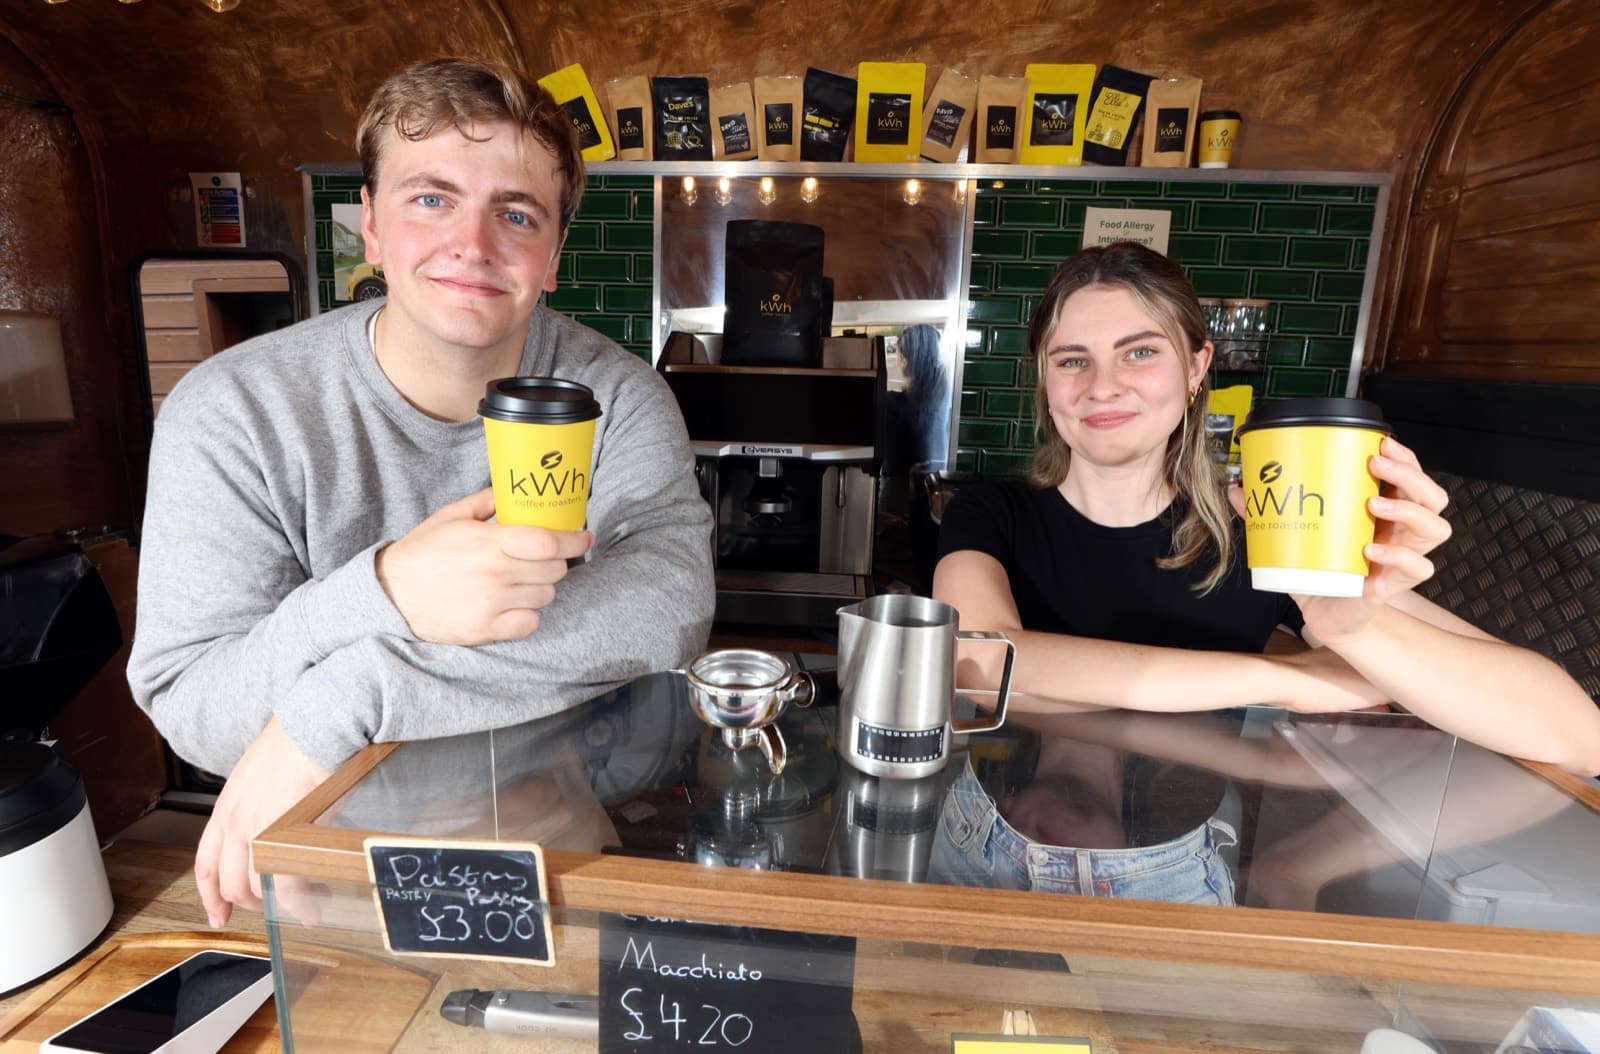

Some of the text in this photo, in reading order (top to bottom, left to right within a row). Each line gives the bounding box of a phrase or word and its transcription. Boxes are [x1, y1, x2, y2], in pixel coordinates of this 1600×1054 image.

[668, 101, 694, 110] Dave's
[768, 121, 789, 129] kWh
[878, 117, 903, 128] kWh
[1042, 119, 1067, 129] kWh
[991, 125, 1011, 133] kWh
[1160, 127, 1183, 136] kWh
[1100, 220, 1155, 232] Food Allergy
[760, 300, 792, 313] kWh
[510, 467, 585, 497] kWh
[514, 499, 545, 508] coffee
[386, 887, 432, 902] PASTRY
[418, 905, 535, 943] £3.00
[618, 936, 763, 981] Macchiato
[620, 987, 753, 1046] £4.20
